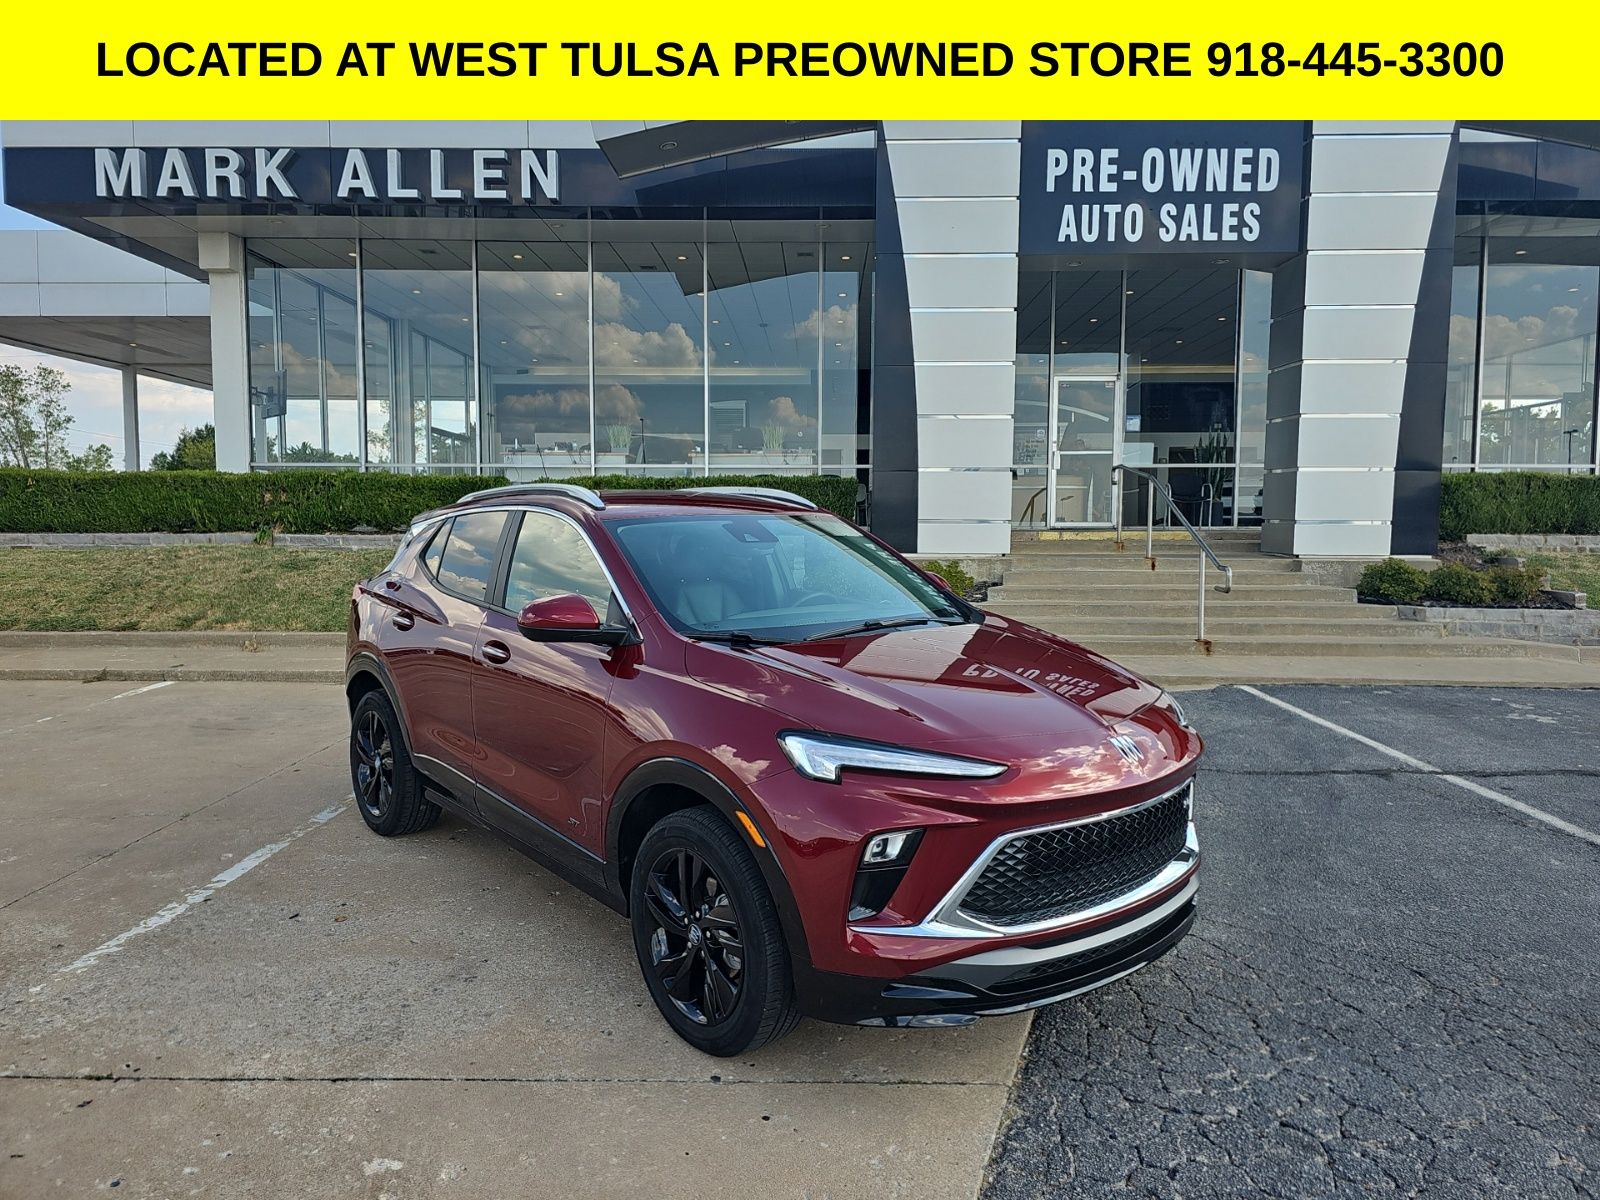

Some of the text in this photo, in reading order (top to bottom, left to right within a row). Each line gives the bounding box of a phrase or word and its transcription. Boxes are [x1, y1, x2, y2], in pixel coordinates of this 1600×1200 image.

[95, 147, 560, 200] MARK ALLEN
[1046, 147, 1280, 193] PRE-OWNED
[1057, 202, 1261, 243] AUTO SALES
